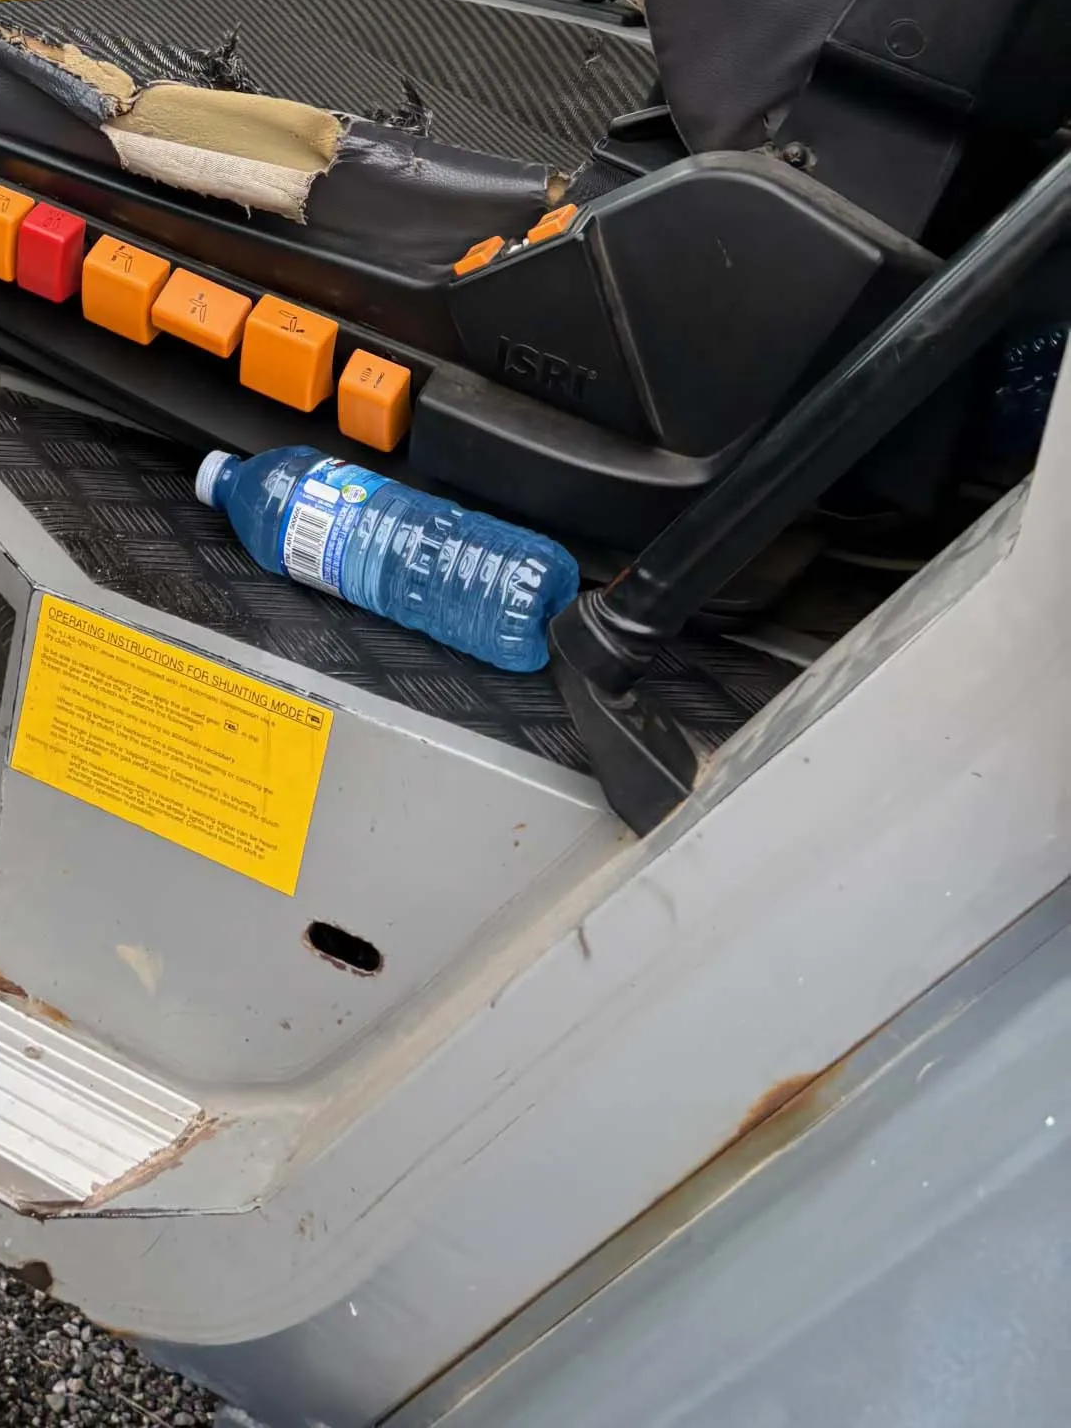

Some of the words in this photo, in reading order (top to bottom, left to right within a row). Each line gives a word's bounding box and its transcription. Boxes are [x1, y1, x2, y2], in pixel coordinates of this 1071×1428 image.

[47, 605, 105, 639] OPERATING
[107, 630, 184, 672] INSTRUCTIONS
[185, 663, 209, 682] FOR
[210, 673, 268, 707] SHUNTING
[270, 697, 305, 722] MODE
